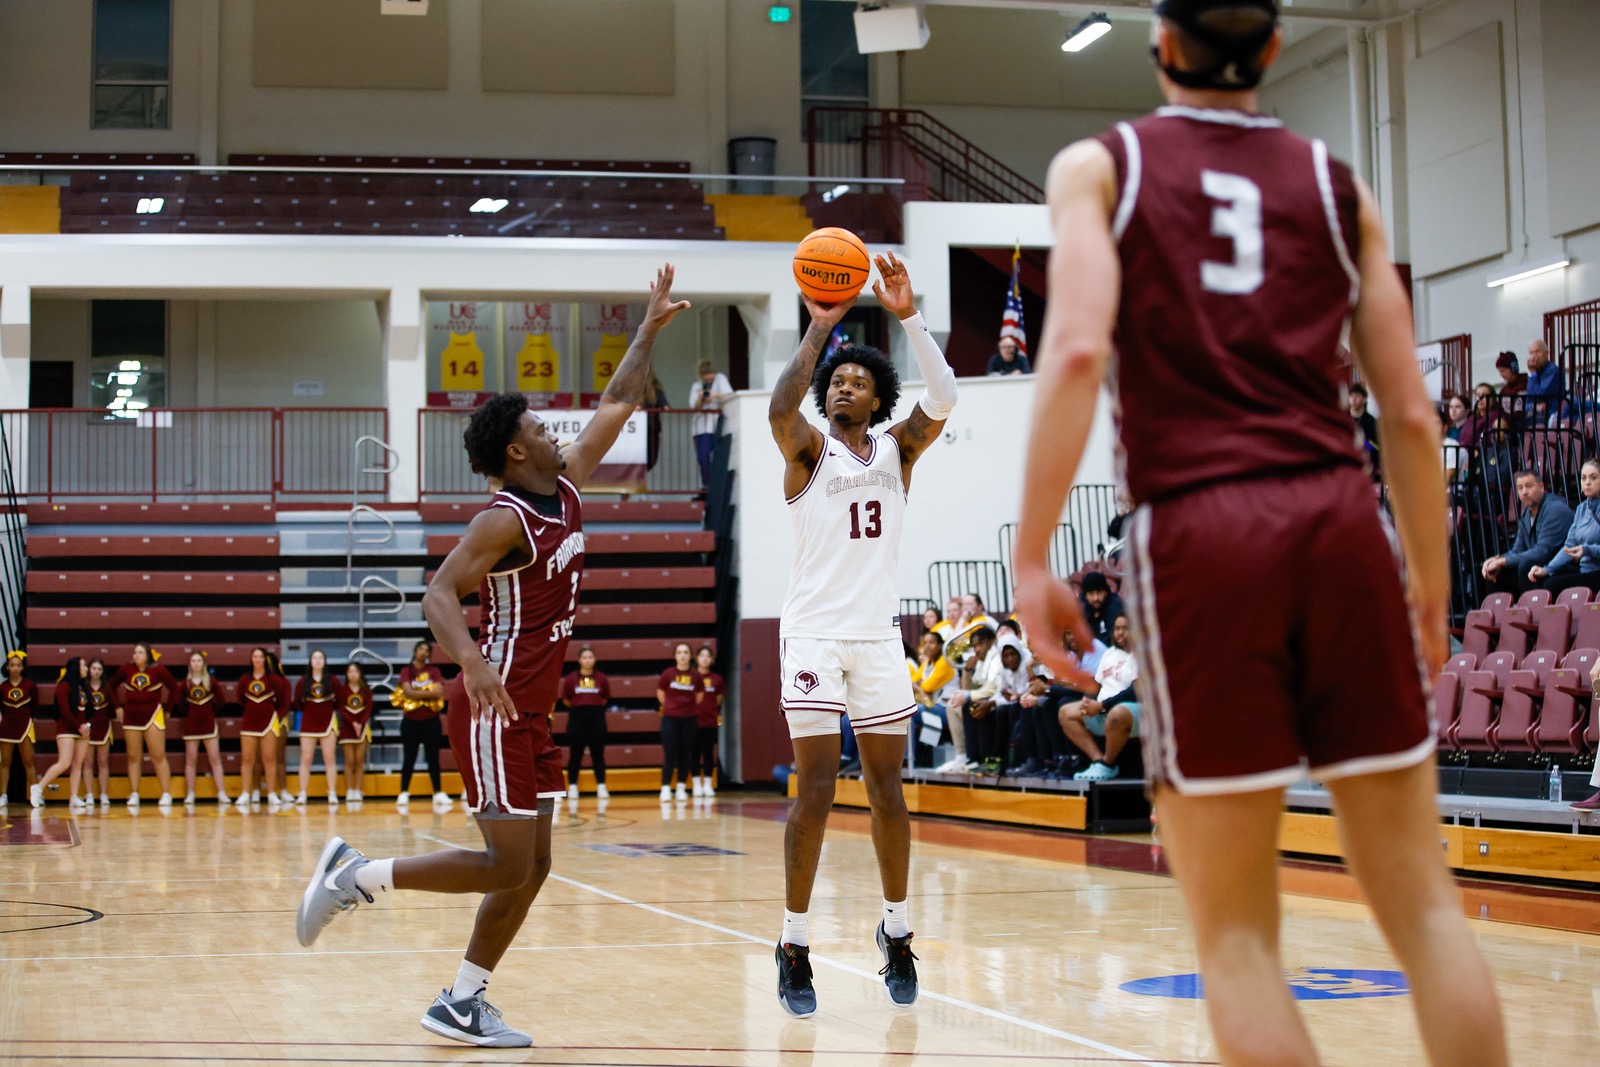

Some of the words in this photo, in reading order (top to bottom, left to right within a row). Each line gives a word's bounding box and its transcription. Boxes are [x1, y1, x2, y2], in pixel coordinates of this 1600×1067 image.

[1201, 170, 1263, 294] 3
[802, 266, 850, 284] Wilson
[448, 361, 479, 377] 14
[522, 361, 554, 378] 23
[826, 470, 898, 498] CHARLESTON
[849, 500, 882, 539] 13
